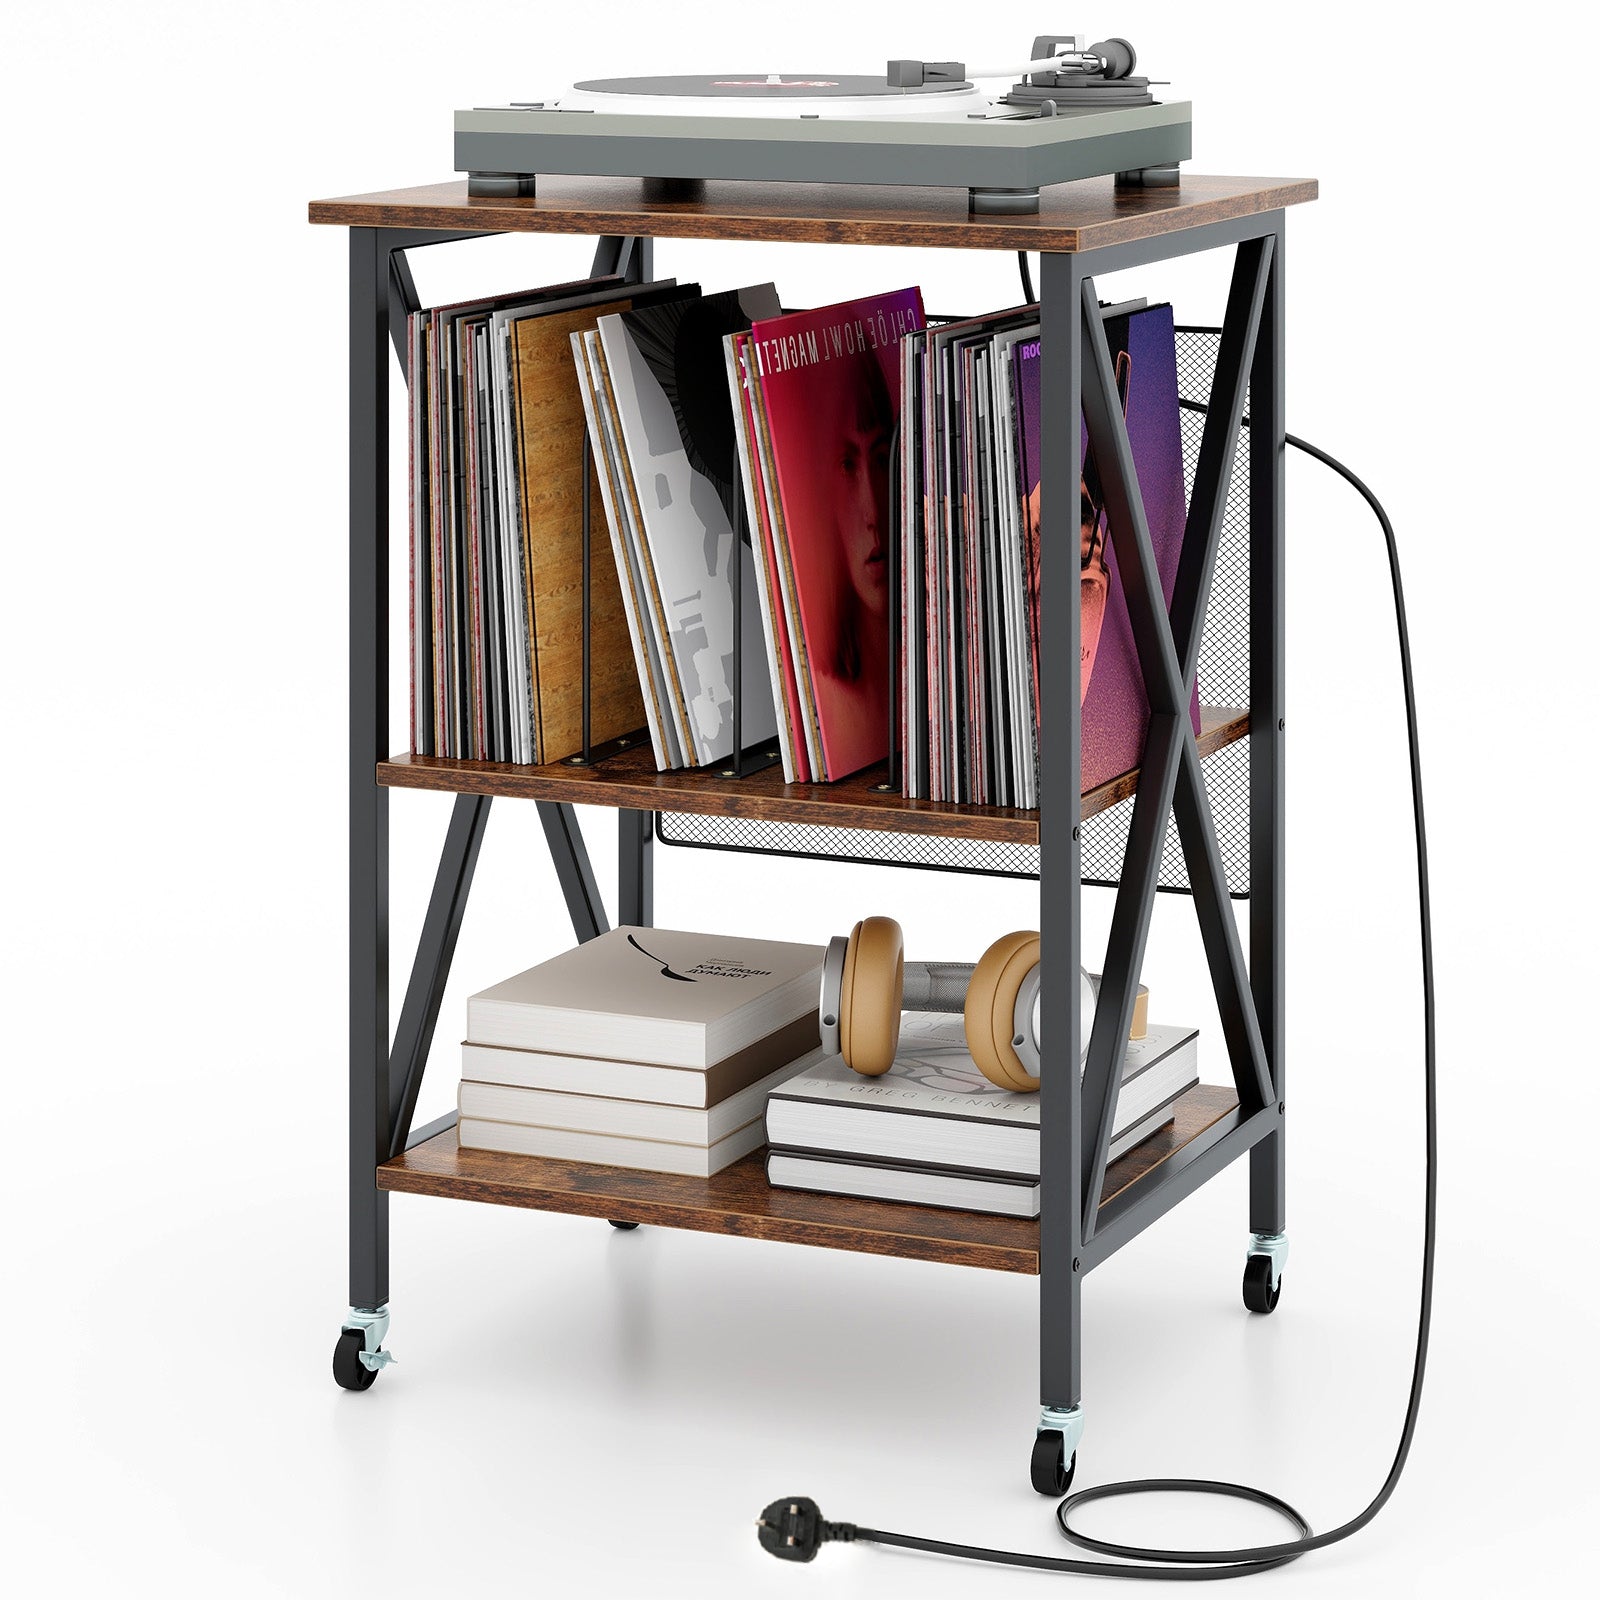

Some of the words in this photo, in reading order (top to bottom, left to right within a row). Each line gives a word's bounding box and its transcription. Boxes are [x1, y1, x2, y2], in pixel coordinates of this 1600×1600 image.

[684, 968, 752, 979] ДУМАЮТ
[695, 964, 722, 972] КАК
[725, 967, 772, 976] ЛЮДИ
[802, 1080, 838, 1088] BY
[849, 1085, 918, 1099] GREG
[930, 1094, 1038, 1112] BENNET
